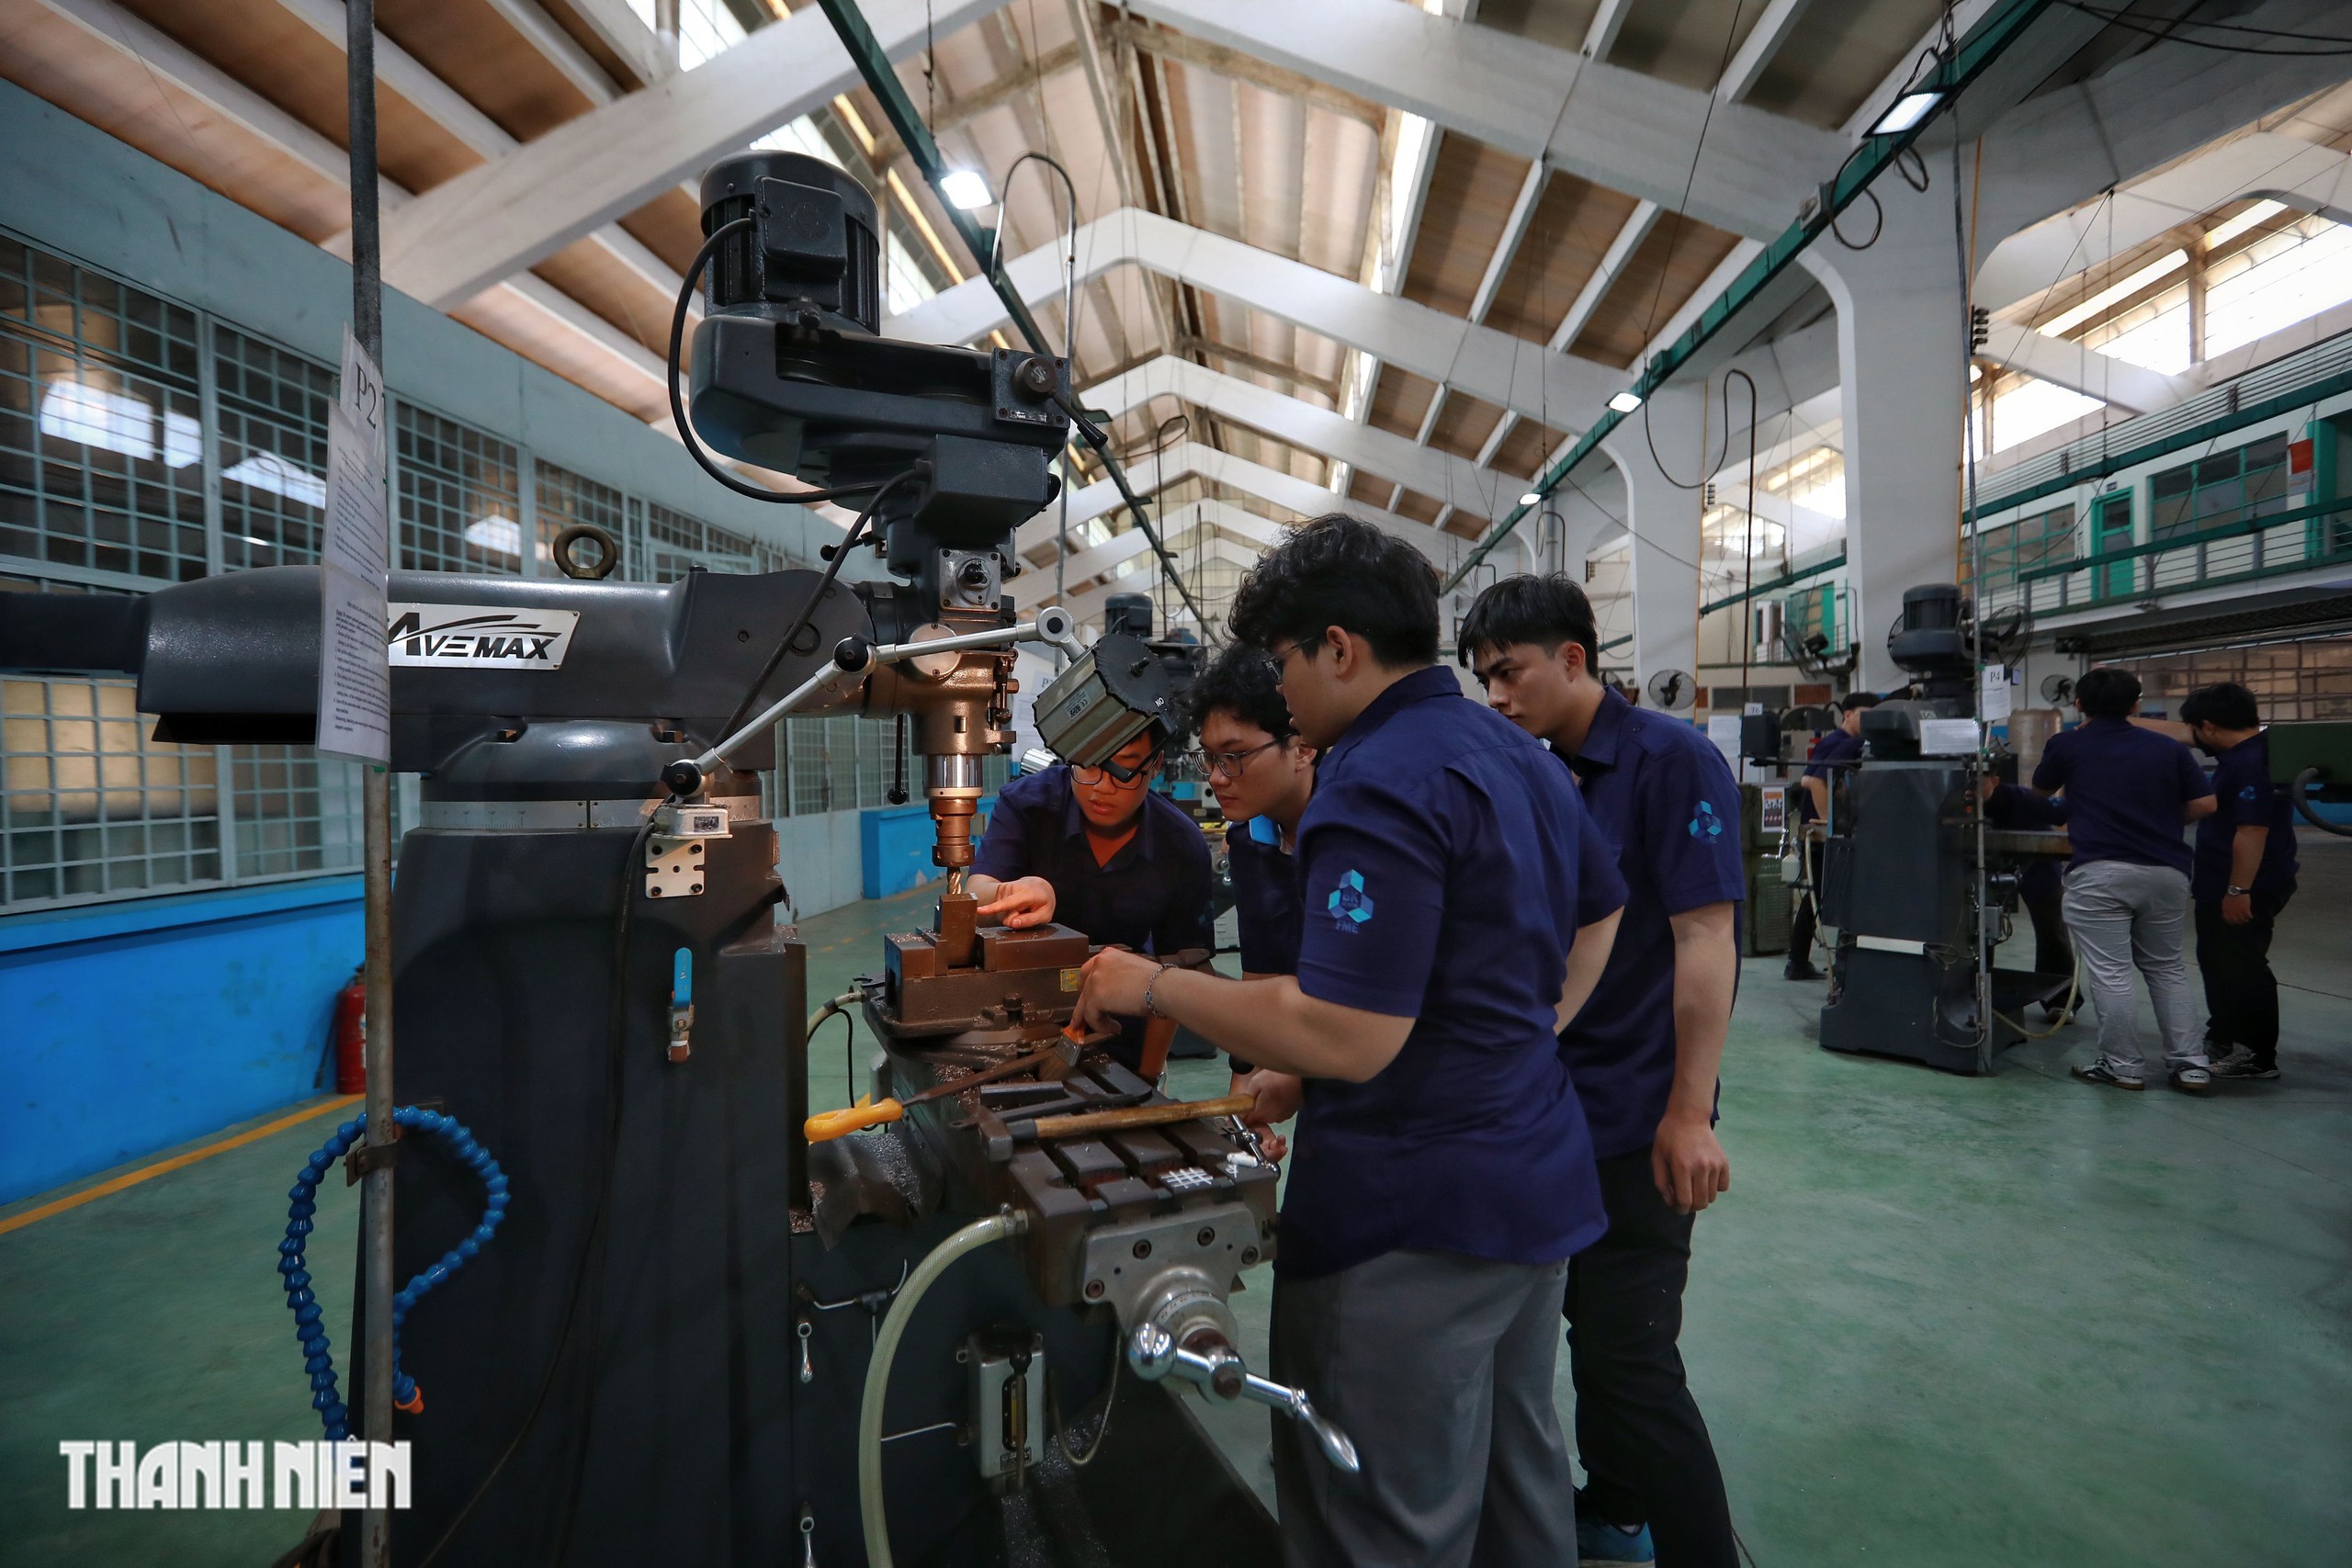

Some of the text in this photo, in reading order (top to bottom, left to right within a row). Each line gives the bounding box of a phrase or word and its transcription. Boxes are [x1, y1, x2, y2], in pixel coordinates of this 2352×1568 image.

[355, 361, 377, 430] P2
[389, 612, 555, 660] AVEMAX
[1990, 671, 2000, 682] P4
[1336, 919, 1359, 934] FME
